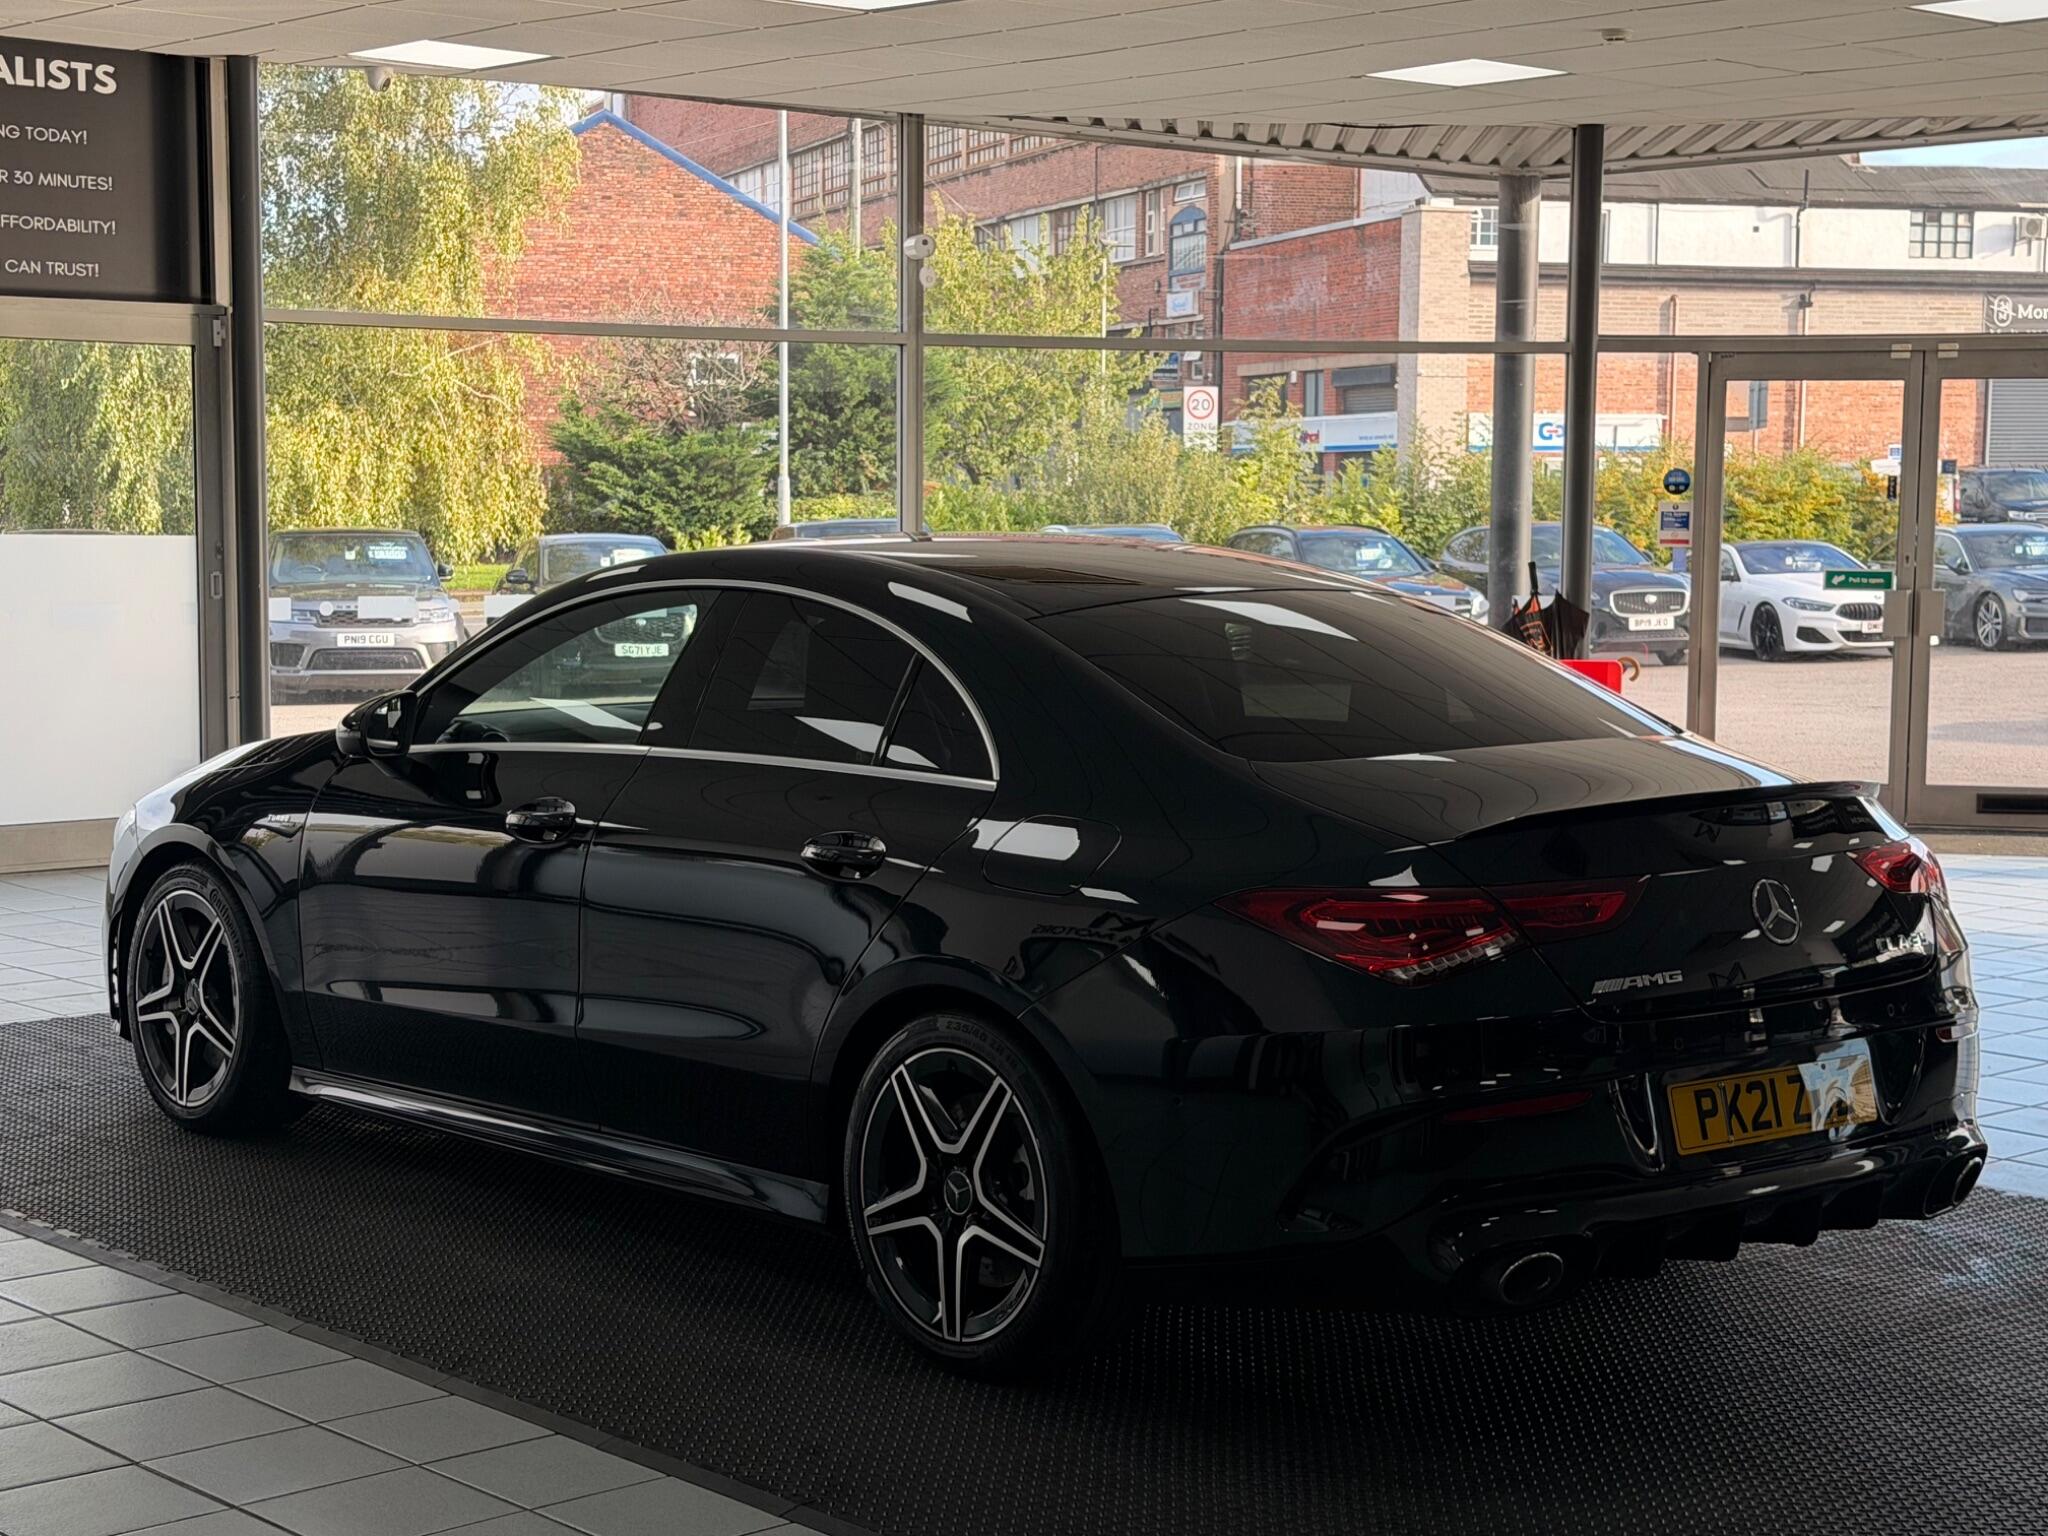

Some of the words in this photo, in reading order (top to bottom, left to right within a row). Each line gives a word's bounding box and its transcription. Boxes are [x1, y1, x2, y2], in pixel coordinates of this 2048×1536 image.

[0, 54, 117, 94] ALISTS
[25, 126, 87, 144] TODAY!
[14, 170, 33, 185] 30
[38, 172, 113, 191] MINUTES!
[0, 214, 116, 235] FFORDABILITY!
[5, 259, 41, 274] CAN
[46, 261, 99, 277] TRUST!
[1192, 398, 1210, 411] 20
[1187, 422, 1215, 431] ZONE
[344, 635, 367, 645] PN19
[368, 635, 389, 645] CGU
[1621, 969, 1684, 990] AMG
[1693, 1077, 1783, 1140] PK21
